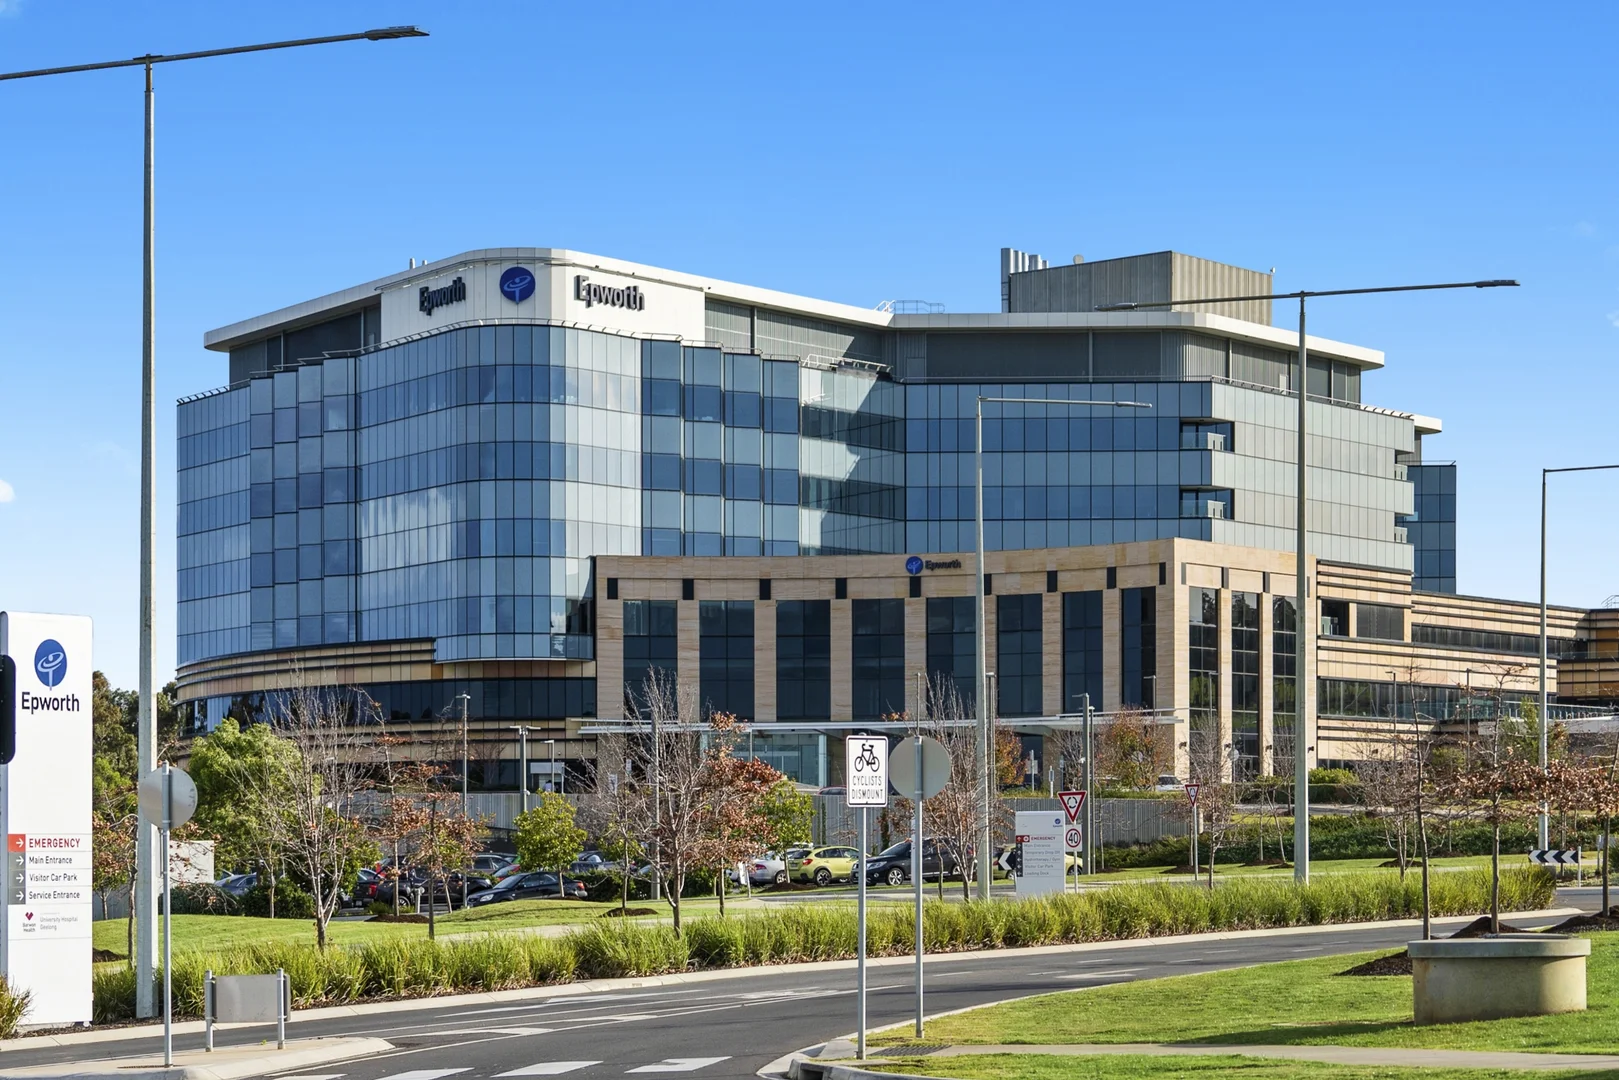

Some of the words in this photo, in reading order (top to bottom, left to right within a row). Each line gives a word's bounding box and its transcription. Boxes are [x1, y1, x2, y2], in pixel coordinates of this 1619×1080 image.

[419, 276, 466, 316] Epworth
[574, 275, 644, 311] Epworth
[925, 559, 961, 571] Epworth
[21, 691, 80, 714] Epworth
[853, 776, 882, 786] CYCLISTS
[852, 789, 883, 799] DISMOUNT
[29, 838, 80, 848] EMERGENCY
[1068, 832, 1078, 844] 40
[29, 856, 44, 864] Main
[46, 856, 72, 864] Entrance
[29, 873, 50, 882] Visitor
[50, 873, 62, 882] Car
[63, 873, 78, 881] Park
[29, 891, 51, 899] Service
[53, 890, 80, 899] Entrance
